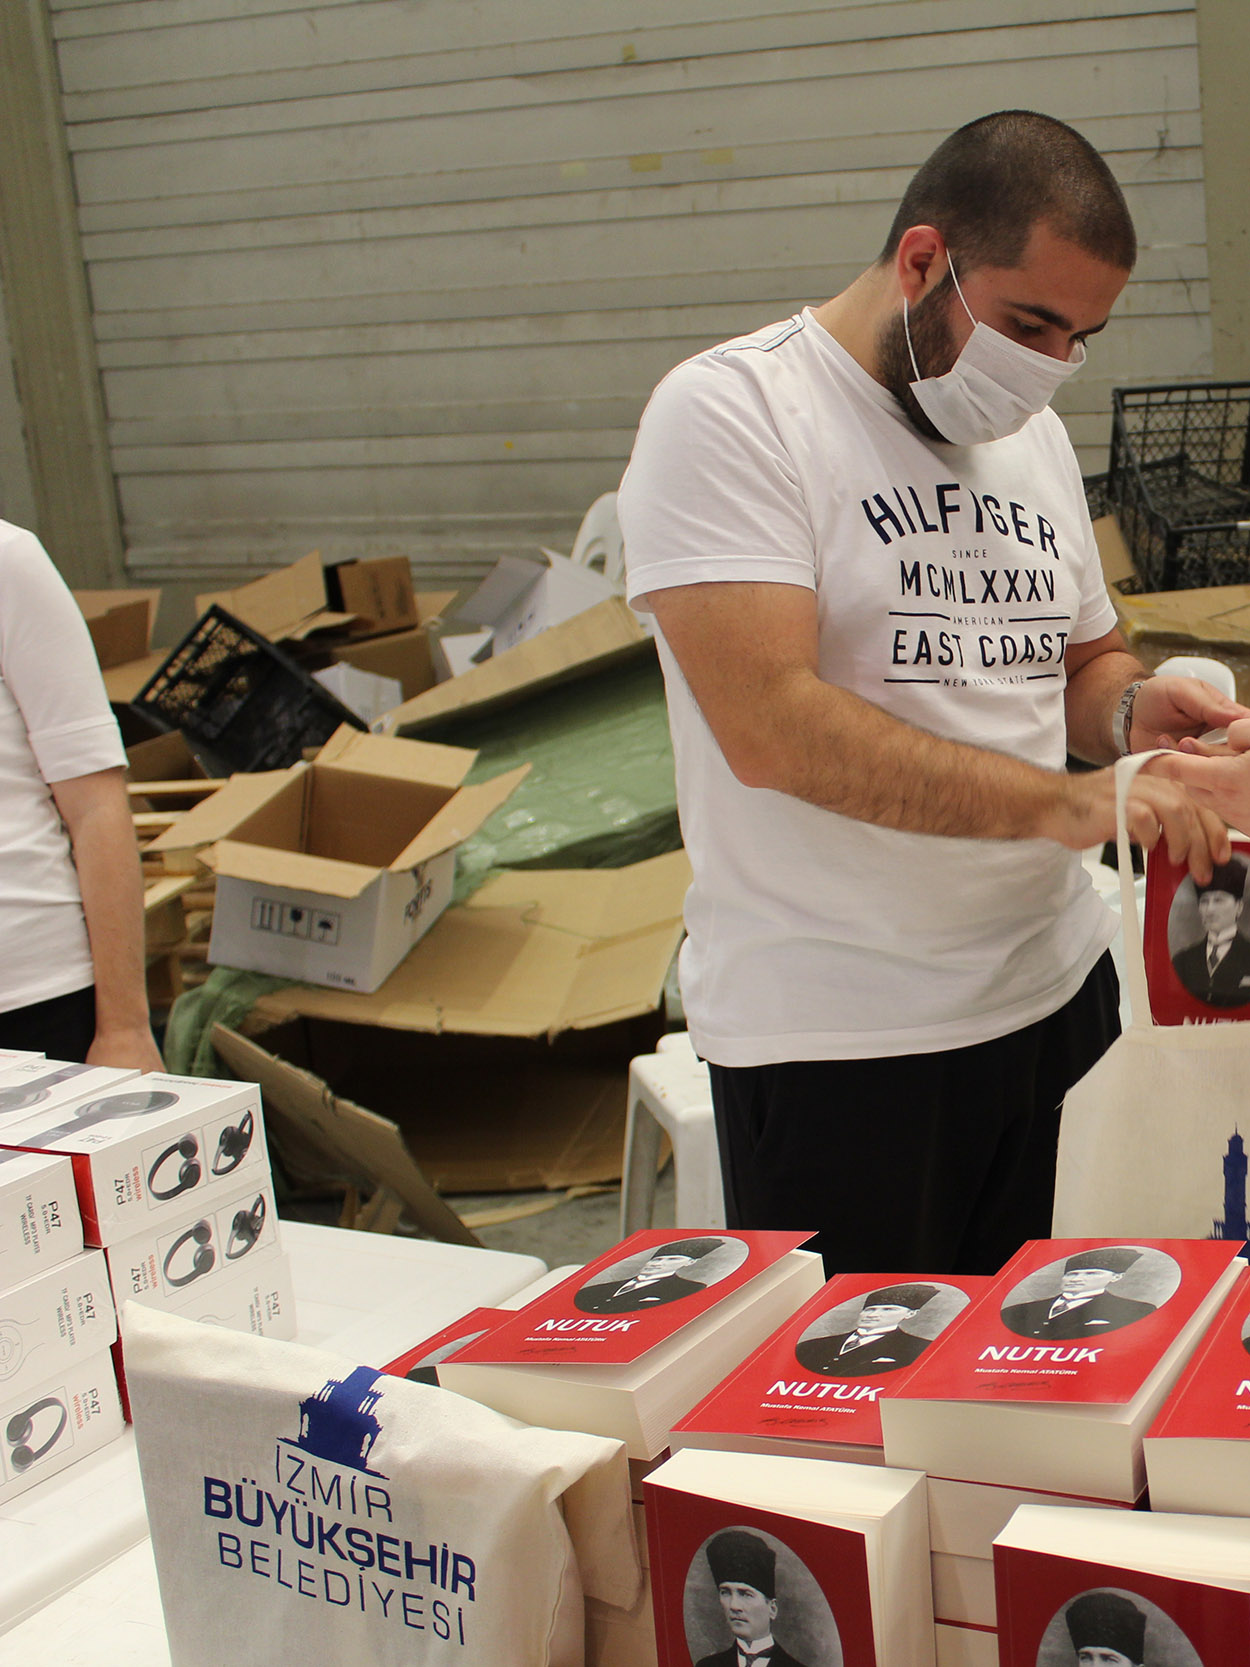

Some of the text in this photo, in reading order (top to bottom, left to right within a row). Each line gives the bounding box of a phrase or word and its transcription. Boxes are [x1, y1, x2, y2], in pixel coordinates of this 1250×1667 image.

[861, 483, 1060, 560] HILFIGER
[952, 549, 988, 559] SINCE
[900, 560, 1055, 604] MCMLXXXV
[953, 616, 1004, 625] AMERICAN
[892, 629, 1068, 668] EAST COAST
[943, 678, 968, 688] NEW
[114, 1178, 126, 1206] P47
[132, 1165, 142, 1202] wireless
[48, 1200, 62, 1228] P47
[20, 1212, 32, 1246] WIRELESS
[131, 1267, 143, 1294] P47
[148, 1254, 158, 1289] wireless
[83, 1292, 96, 1319] P47
[271, 1290, 281, 1316] P47
[534, 1318, 641, 1333] NUTUK
[977, 1345, 1105, 1364] NUTUK
[974, 1367, 1079, 1376] Mustafa Kemal ATATÜRK
[88, 1387, 101, 1415] P47
[766, 1380, 886, 1402] NUTUK
[72, 1393, 84, 1430] wireless
[760, 1401, 857, 1414] Mustafa Kemal ATATÜRK
[275, 1444, 393, 1523] İZMİR
[203, 1476, 477, 1601] BÜYÜKŞEHİR
[218, 1531, 465, 1646] BELEDİYESİ
